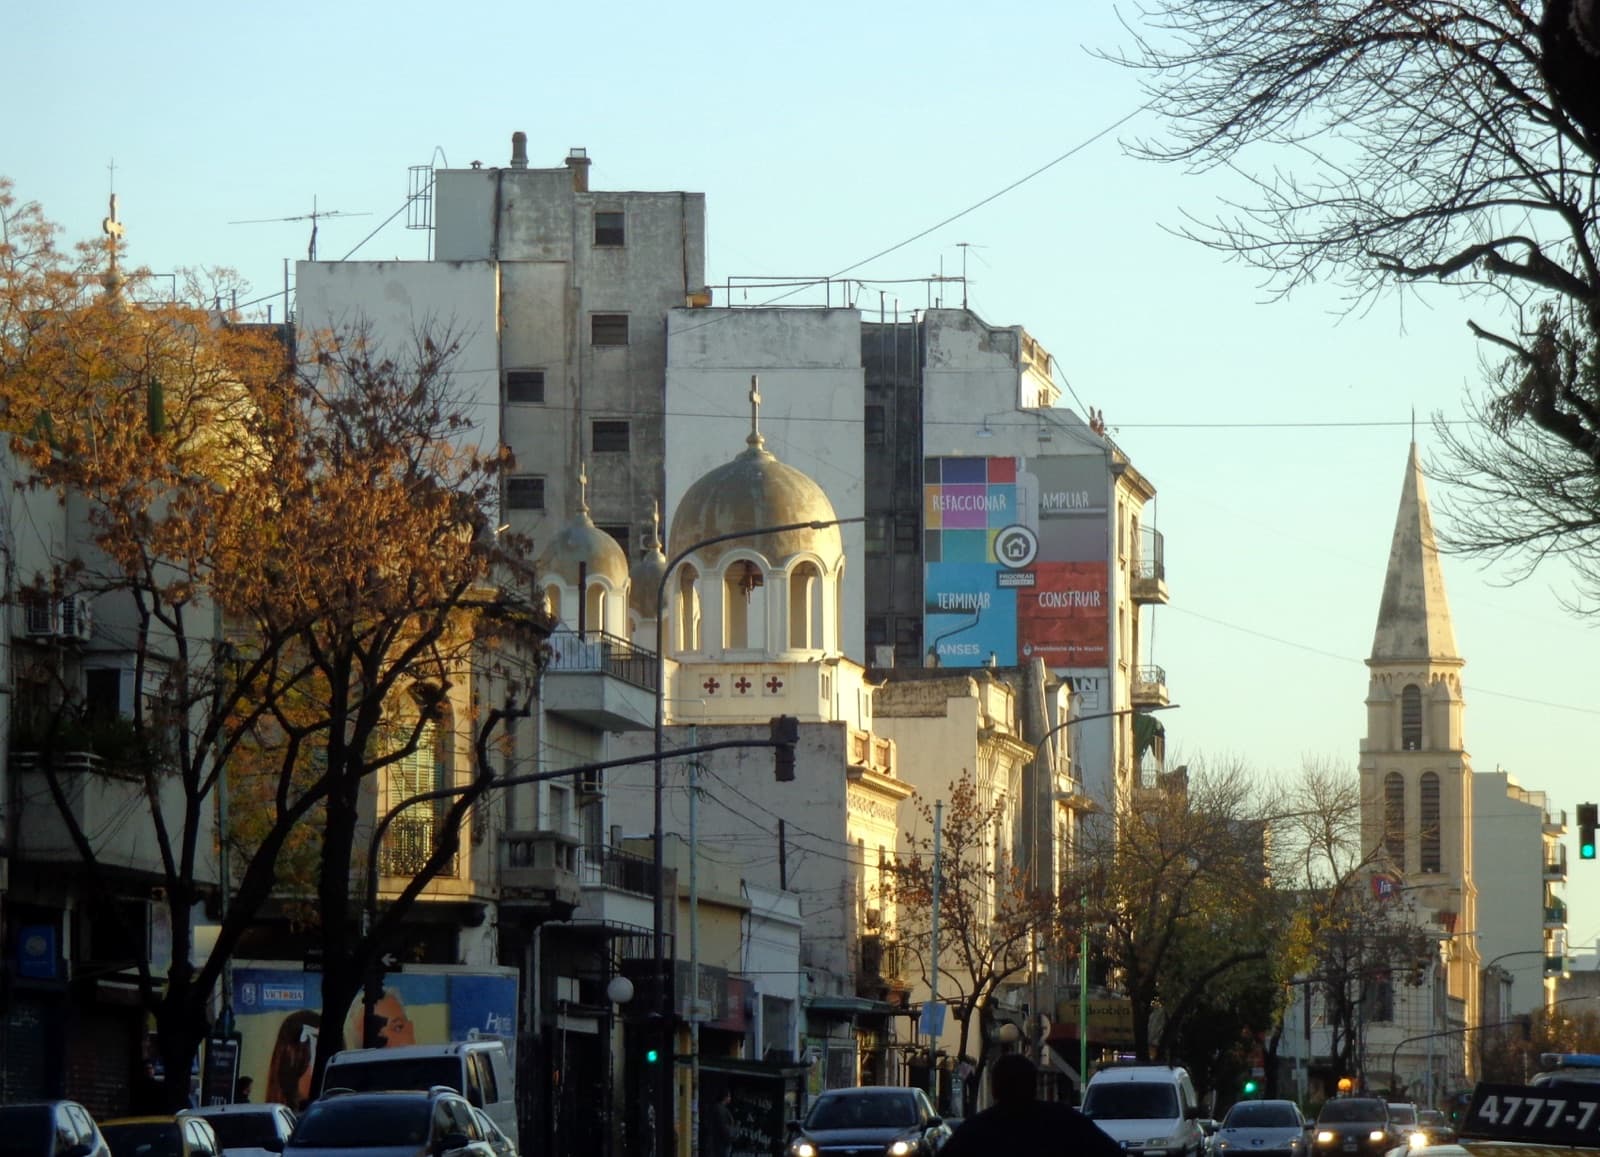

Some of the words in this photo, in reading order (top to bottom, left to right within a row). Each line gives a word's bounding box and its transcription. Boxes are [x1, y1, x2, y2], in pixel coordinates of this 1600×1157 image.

[932, 494, 1007, 512] REFACCIONAR
[1042, 491, 1089, 509] AMPLIAR
[937, 592, 991, 609] TERMINAR
[1038, 591, 1101, 608] CONSTRUIR
[936, 643, 980, 655] ANSES
[1478, 1095, 1600, 1131] 4777-7
